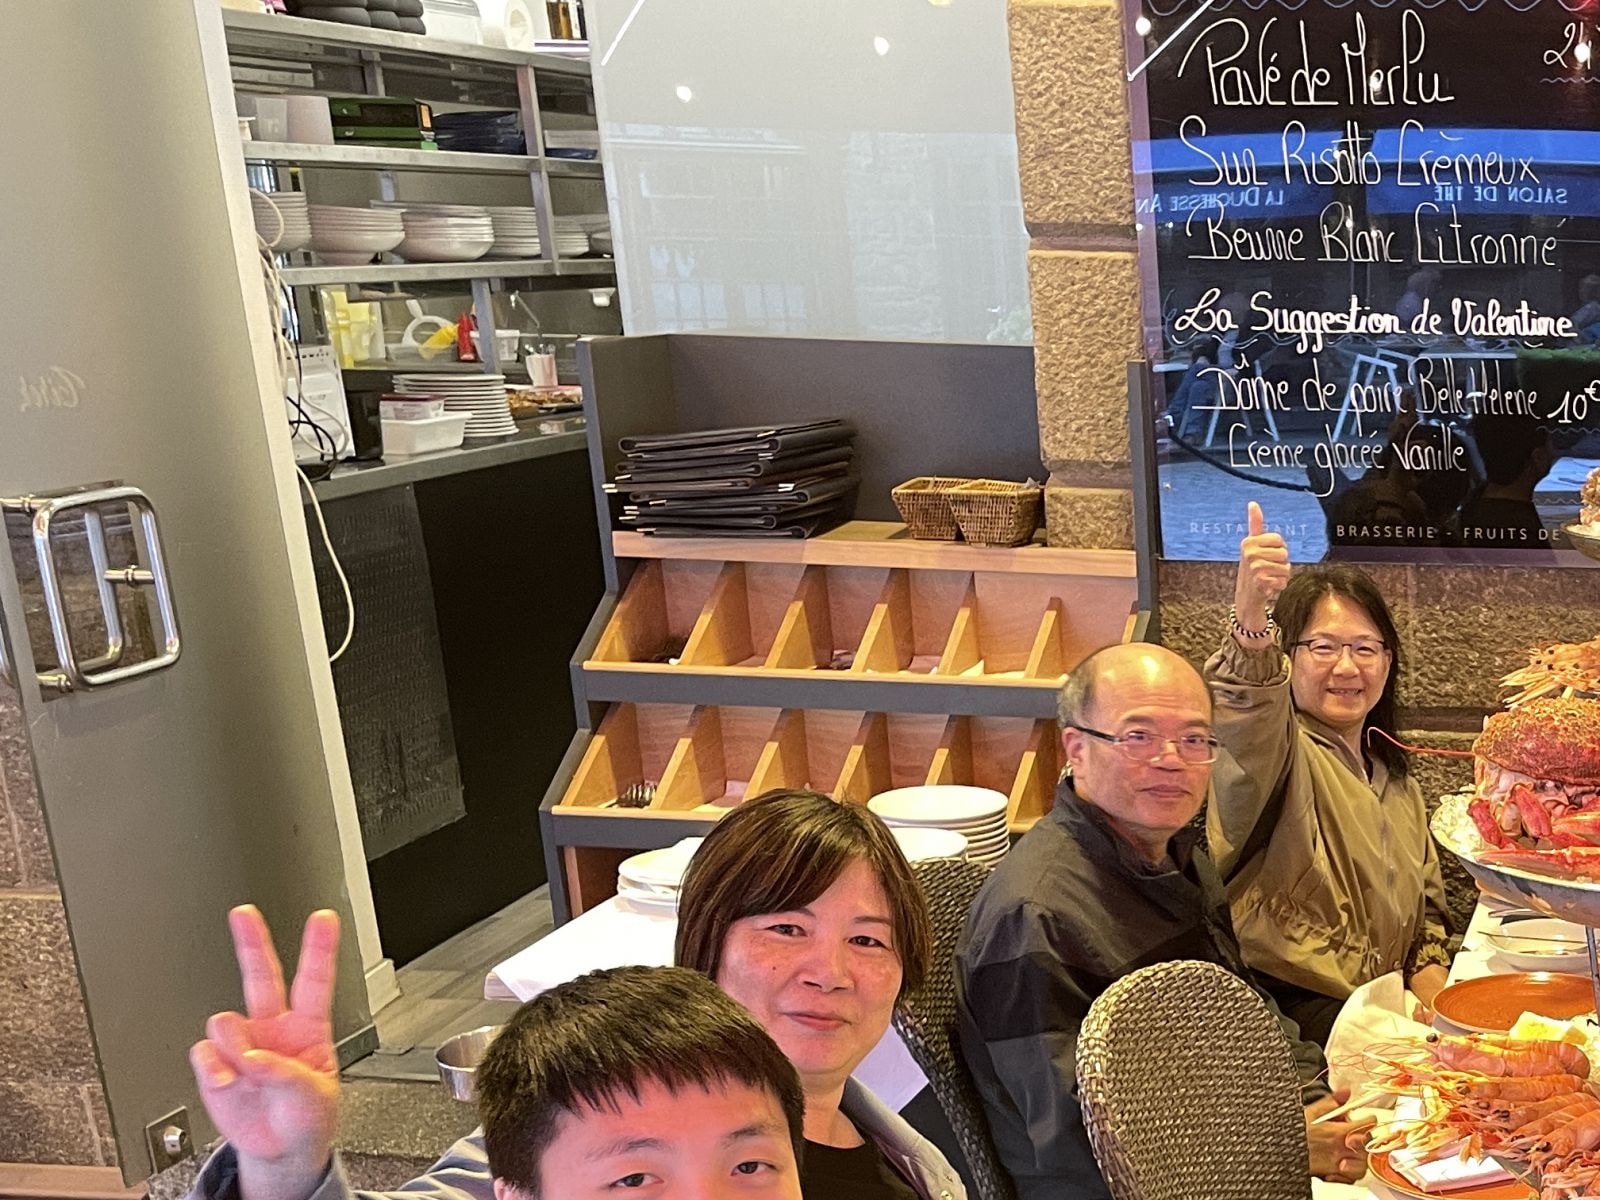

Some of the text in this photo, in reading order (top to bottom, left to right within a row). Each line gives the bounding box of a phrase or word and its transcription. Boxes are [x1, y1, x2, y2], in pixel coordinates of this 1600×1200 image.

[1178, 9, 1454, 105] Pavé de Merlu
[1180, 115, 1268, 185] Sur
[1282, 120, 1381, 185] Risotto
[1318, 201, 1402, 262] Blanc
[1175, 288, 1577, 353] La Suggestion de Valentine
[1303, 358, 1338, 411] de
[1350, 372, 1407, 437] poire
[1229, 423, 1307, 468] Crème
[1392, 419, 1467, 471] Vanille
[1190, 522, 1561, 542] RESTARANT BRASSERIE FRUITS DE
